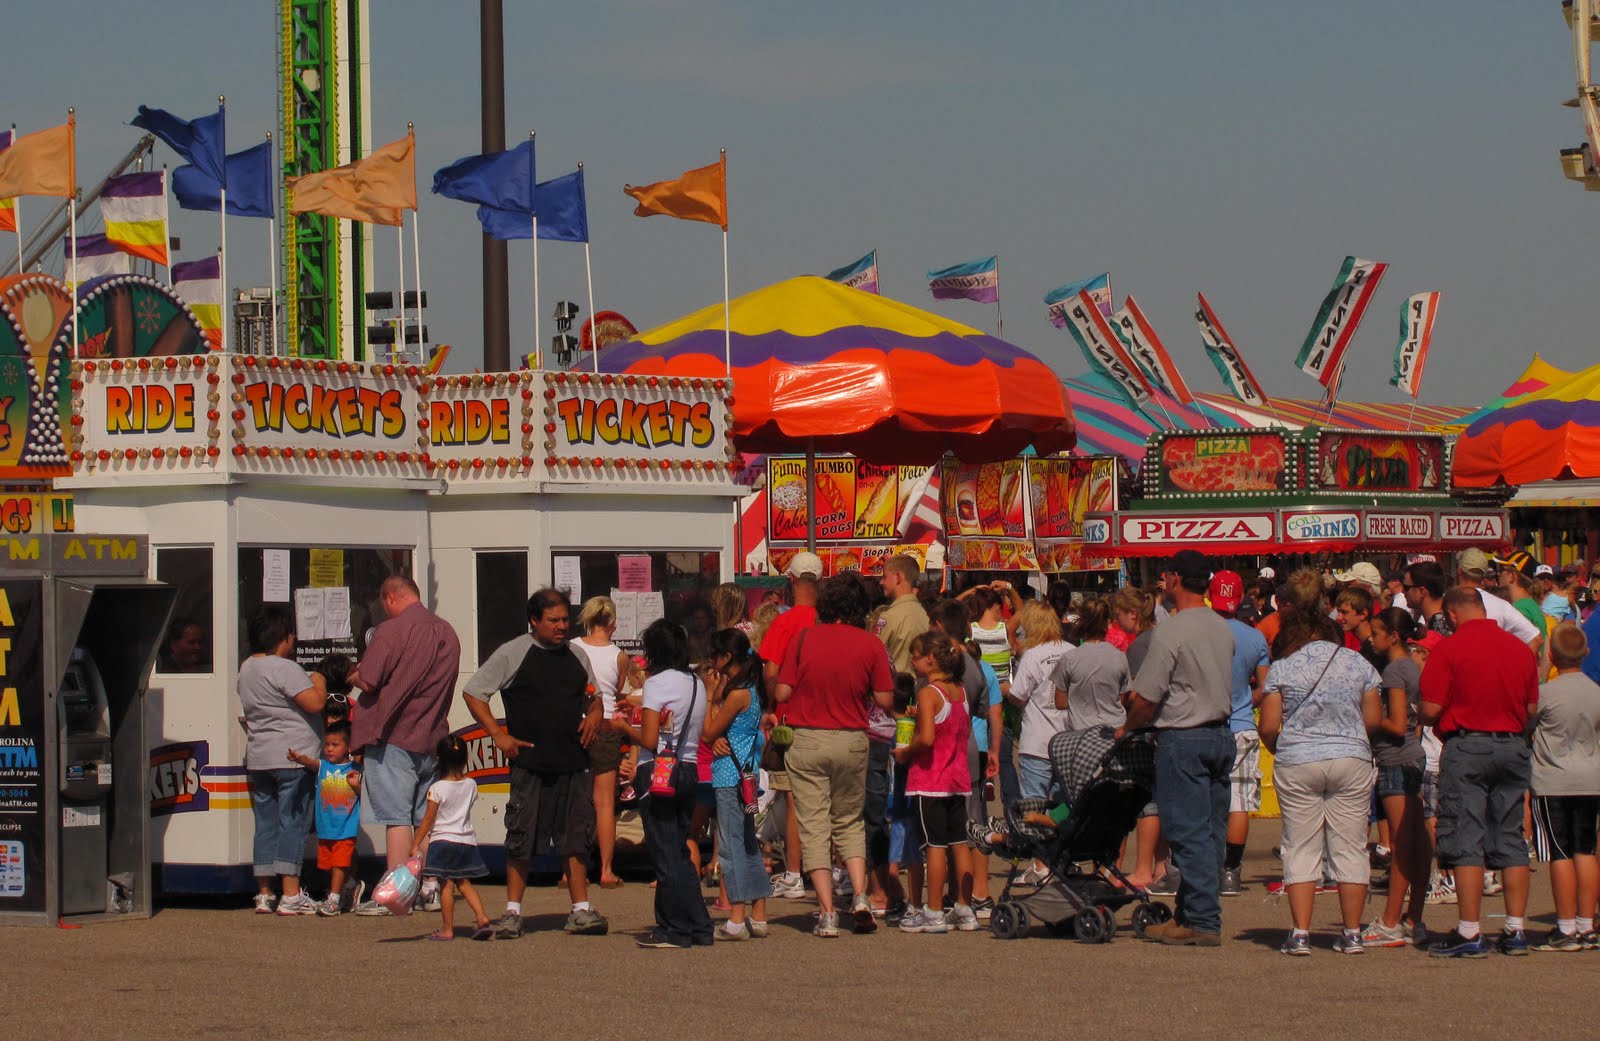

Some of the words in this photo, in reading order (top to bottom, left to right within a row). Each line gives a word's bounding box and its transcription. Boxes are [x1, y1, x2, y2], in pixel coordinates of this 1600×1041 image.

[106, 383, 195, 434] RIDE
[245, 381, 407, 438] TICKETS
[430, 398, 511, 446] RIDE
[558, 396, 715, 449] TICKETS
[1197, 439, 1250, 455] PIZZA
[773, 461, 808, 484] Funne
[815, 461, 854, 474] JUMBO
[1296, 446, 1306, 489] PIZZA
[815, 511, 846, 526] CORN
[855, 519, 892, 536] STICK
[1288, 514, 1323, 531] COLD
[1301, 516, 1358, 539] DRINKS
[1369, 517, 1396, 537] FRESH
[1399, 517, 1429, 537] BAKED
[1446, 518, 1497, 537] PIZZA
[822, 521, 853, 536] DOGS
[1137, 519, 1261, 541] PIZZA
[64, 538, 138, 561] ATM
[863, 547, 894, 557] Sloppy
[1220, 583, 1233, 598] N
[0, 747, 38, 768] TM
